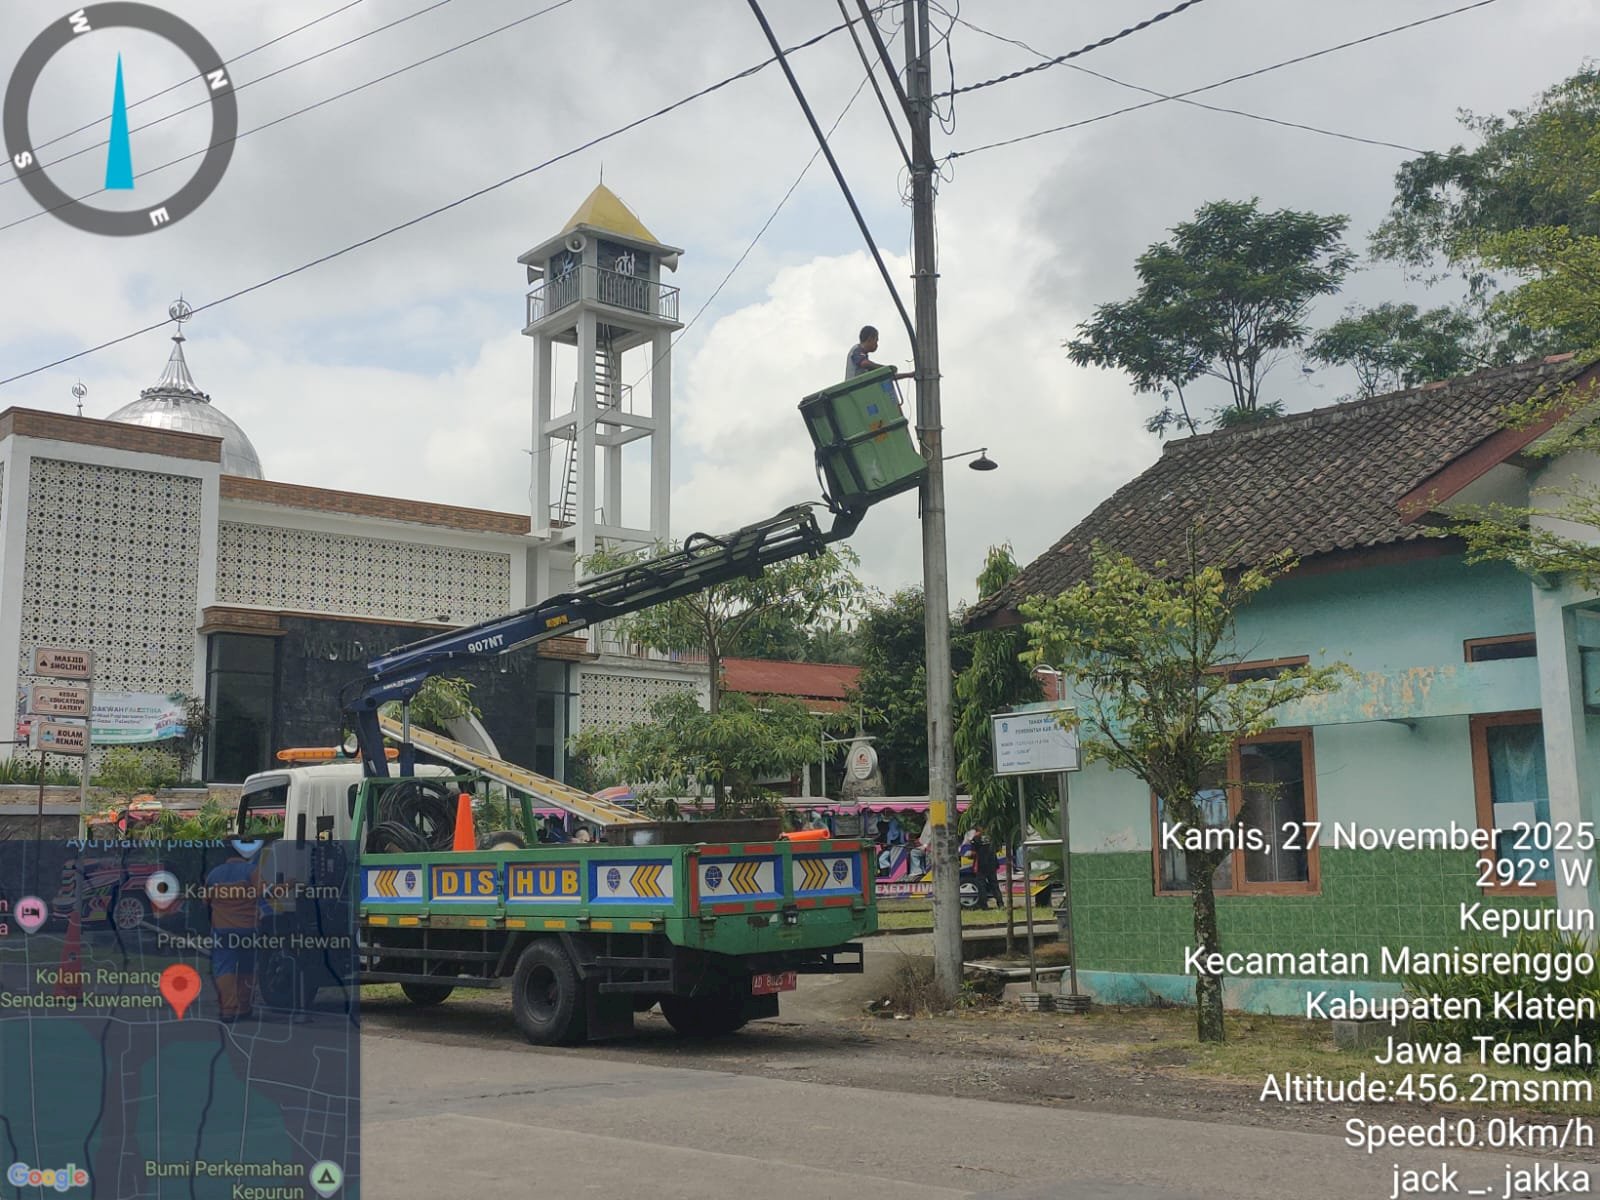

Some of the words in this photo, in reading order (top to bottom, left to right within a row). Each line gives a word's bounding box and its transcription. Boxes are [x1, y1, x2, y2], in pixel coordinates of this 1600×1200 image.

[467, 634, 504, 654] 907NT
[54, 655, 84, 664] MASJID
[50, 662, 87, 672] SHOLIHIN
[49, 697, 85, 705] EDUCATION
[57, 729, 83, 738] KOLAM
[55, 737, 84, 747] RENANG
[516, 870, 579, 895] HUB
